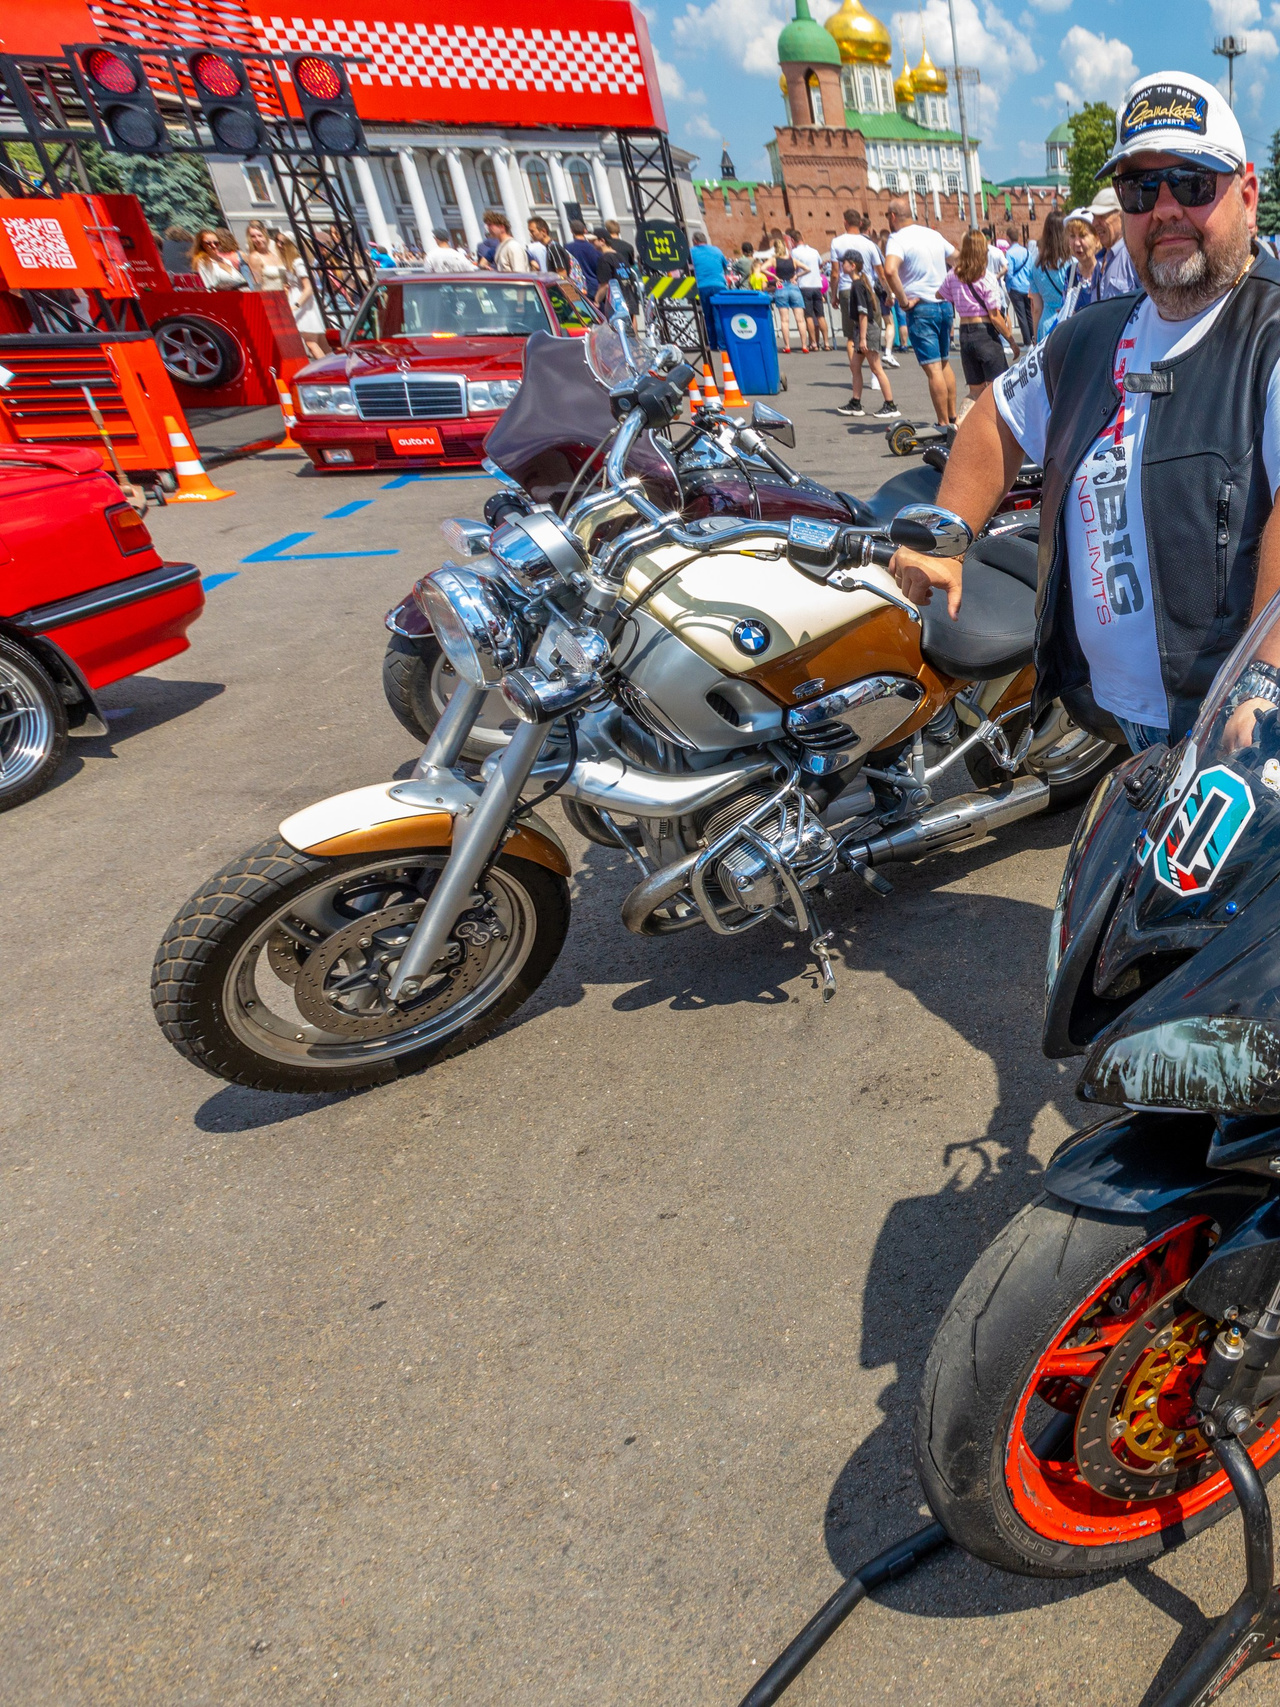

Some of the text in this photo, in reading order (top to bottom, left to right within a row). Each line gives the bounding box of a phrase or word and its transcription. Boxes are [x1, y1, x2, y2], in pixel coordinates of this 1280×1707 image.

[1131, 86, 1197, 109] SIMPLY THE BEST
[1134, 118, 1186, 131] FOR EXPERTS
[398, 437, 435, 446] auto.ru
[1075, 474, 1113, 626] NO LIMITS
[1094, 482, 1145, 616] BIG
[993, 1482, 1055, 1558] SUPERCORSA
